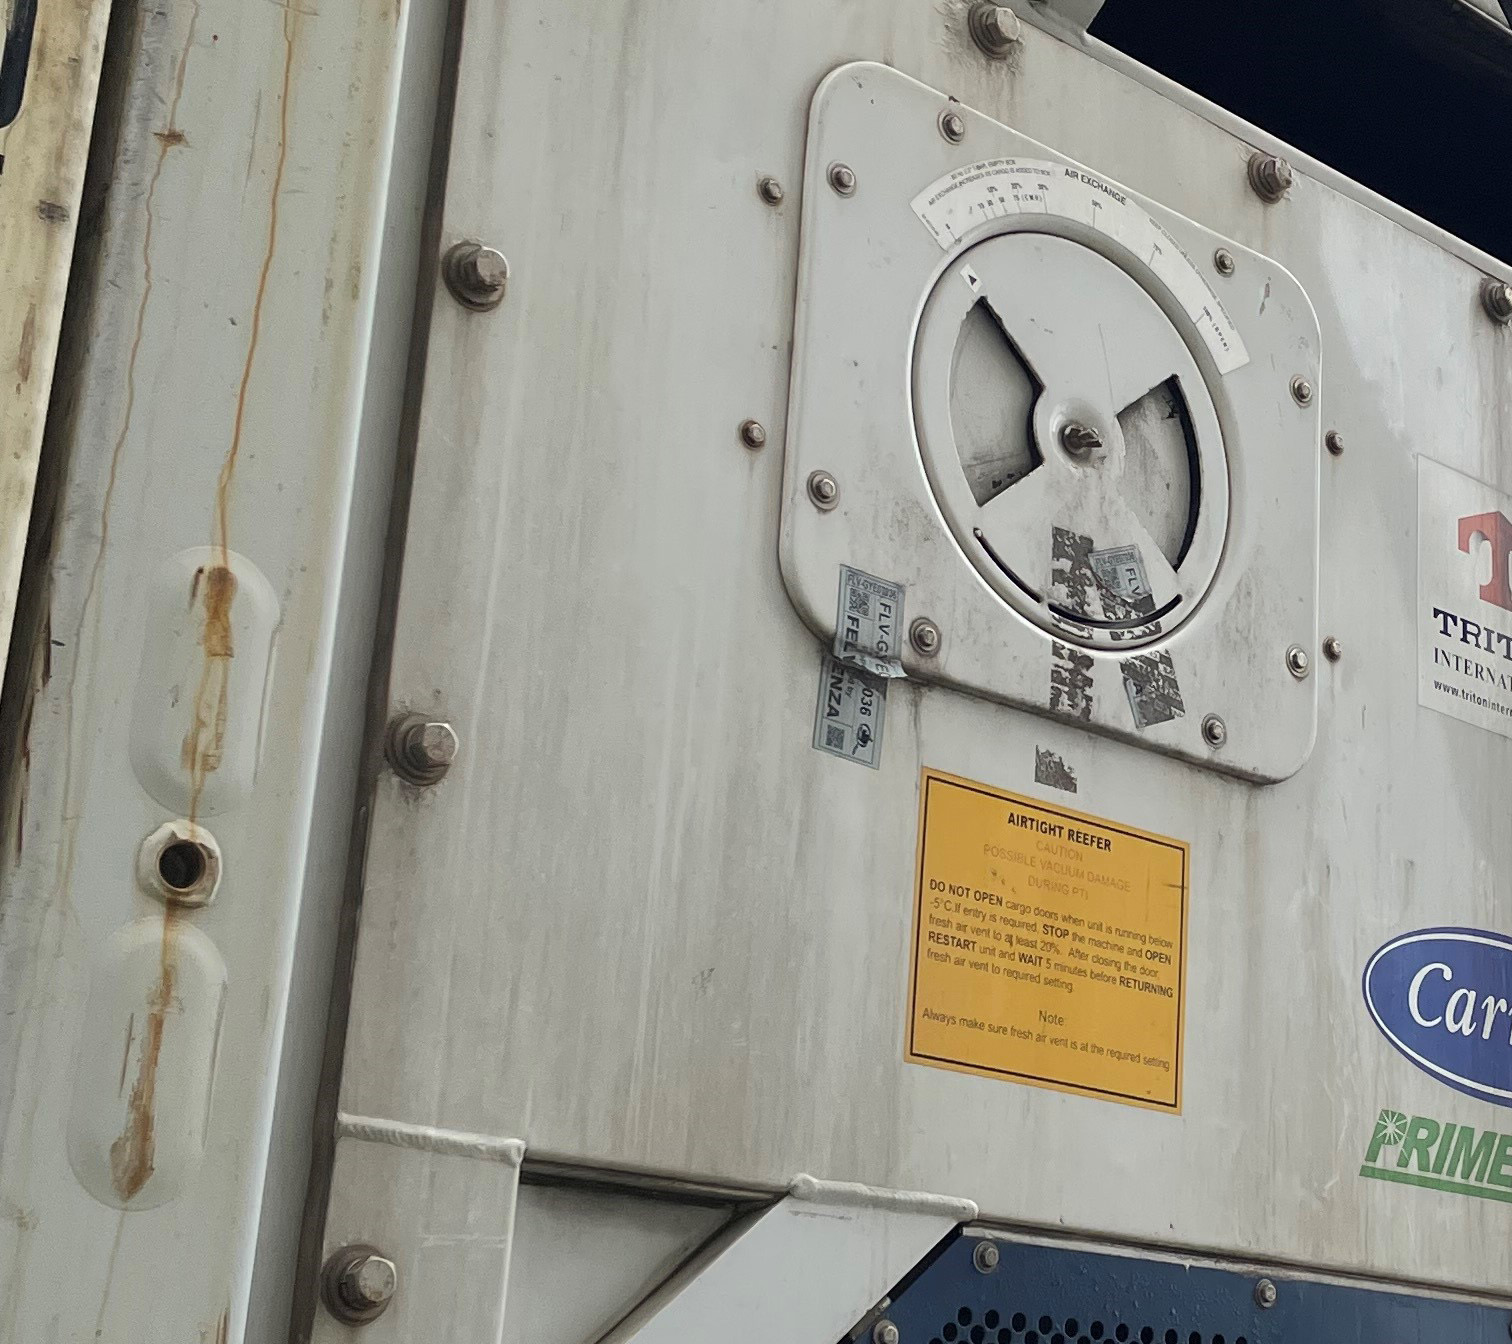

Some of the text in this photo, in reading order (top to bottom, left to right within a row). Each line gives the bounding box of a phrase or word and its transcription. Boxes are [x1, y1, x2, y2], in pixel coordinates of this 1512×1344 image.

[1064, 168, 1127, 206] AIR EXCHANGE
[1124, 567, 1143, 597] FLV
[1007, 812, 1112, 852] AIRTIGHT REEFER
[984, 844, 1036, 869] POSSIBLE
[1087, 870, 1131, 893] DAMAGE
[1037, 841, 1083, 862] CAUTION
[930, 879, 946, 893] DO
[948, 884, 971, 899] NOT
[974, 889, 1003, 907] OPEN
[1006, 899, 1031, 917] cargo
[1034, 905, 1059, 923] doors
[1028, 875, 1069, 895] DURING
[929, 914, 953, 930] fresh
[956, 920, 968, 933] air
[971, 925, 991, 937] vent
[963, 905, 986, 922] entry
[1042, 923, 1070, 939] STOP
[1145, 949, 1171, 966] OPEN
[927, 948, 951, 965] fresh
[953, 956, 965, 968] air
[968, 960, 989, 974] vent
[928, 930, 977, 952] RESTART
[1018, 951, 1044, 967] WAIT
[1119, 975, 1173, 999] RETURNING
[922, 1007, 956, 1027] Always
[959, 1015, 985, 1032] make
[988, 1021, 1008, 1037] sure
[1010, 1024, 1033, 1041] fresh
